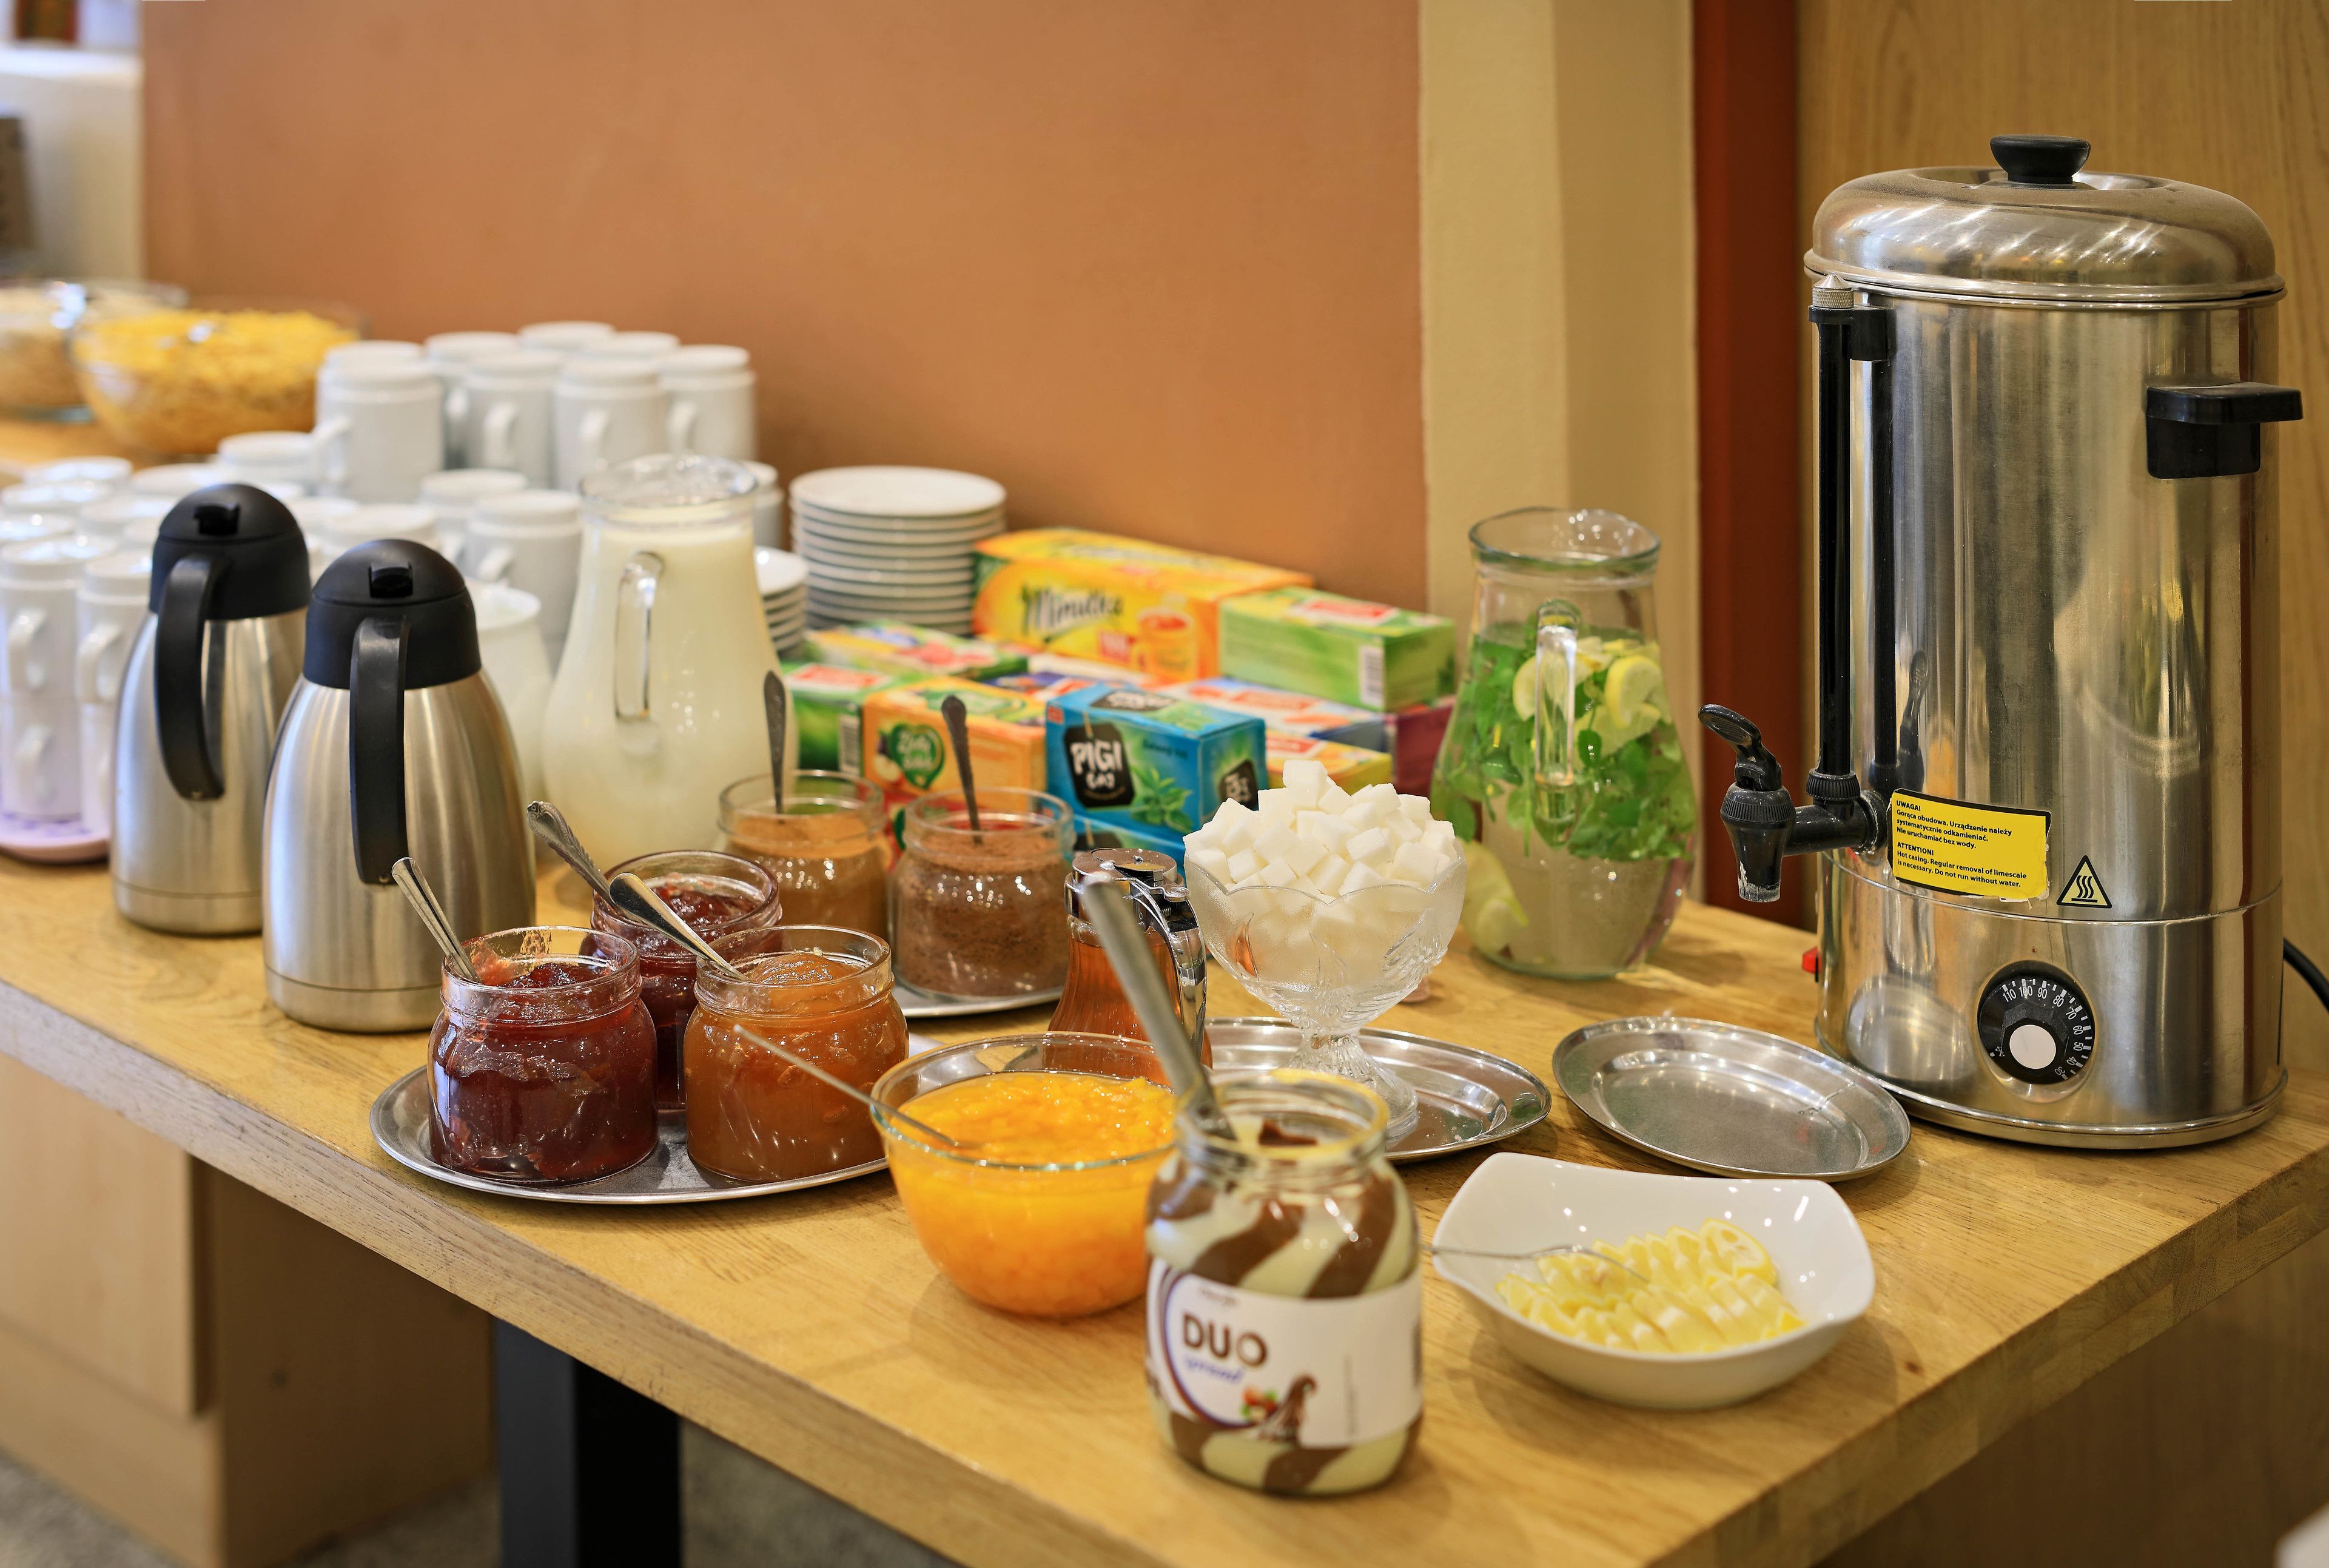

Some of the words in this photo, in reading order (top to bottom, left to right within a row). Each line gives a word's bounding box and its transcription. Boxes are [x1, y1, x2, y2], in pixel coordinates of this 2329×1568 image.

[1069, 739, 1123, 775] PIGI
[1896, 800, 1921, 811] UWAGA!
[1897, 809, 1917, 819] Gorąca
[1917, 815, 1948, 826] obudowa.
[1949, 821, 1988, 832] Urządzenie
[1989, 828, 2012, 836] należy
[1897, 819, 1942, 833] systematycznie
[1943, 830, 1988, 841] odkamieniać.
[1907, 830, 1942, 842] uruchamiać
[1956, 841, 1977, 849] wody.
[1897, 842, 1934, 855] ATTENTION!
[1908, 854, 1929, 864] casing.
[1930, 858, 1955, 869] Regular
[1956, 865, 1984, 873] removal
[1994, 869, 2027, 878] limescale
[1903, 862, 1934, 873] necessary.
[1971, 875, 1997, 884] without
[2003, 989, 2017, 1002] 110
[2019, 985, 2033, 997] 100
[2037, 987, 2048, 999] 90
[2053, 995, 2064, 1007] 80
[2066, 1006, 2077, 1020] 70
[2073, 1025, 2083, 1035] 60
[2073, 1041, 2084, 1051] 50
[2066, 1056, 2077, 1066] 40
[2054, 1066, 2065, 1075] 30
[1182, 1310, 1268, 1367] DUO
